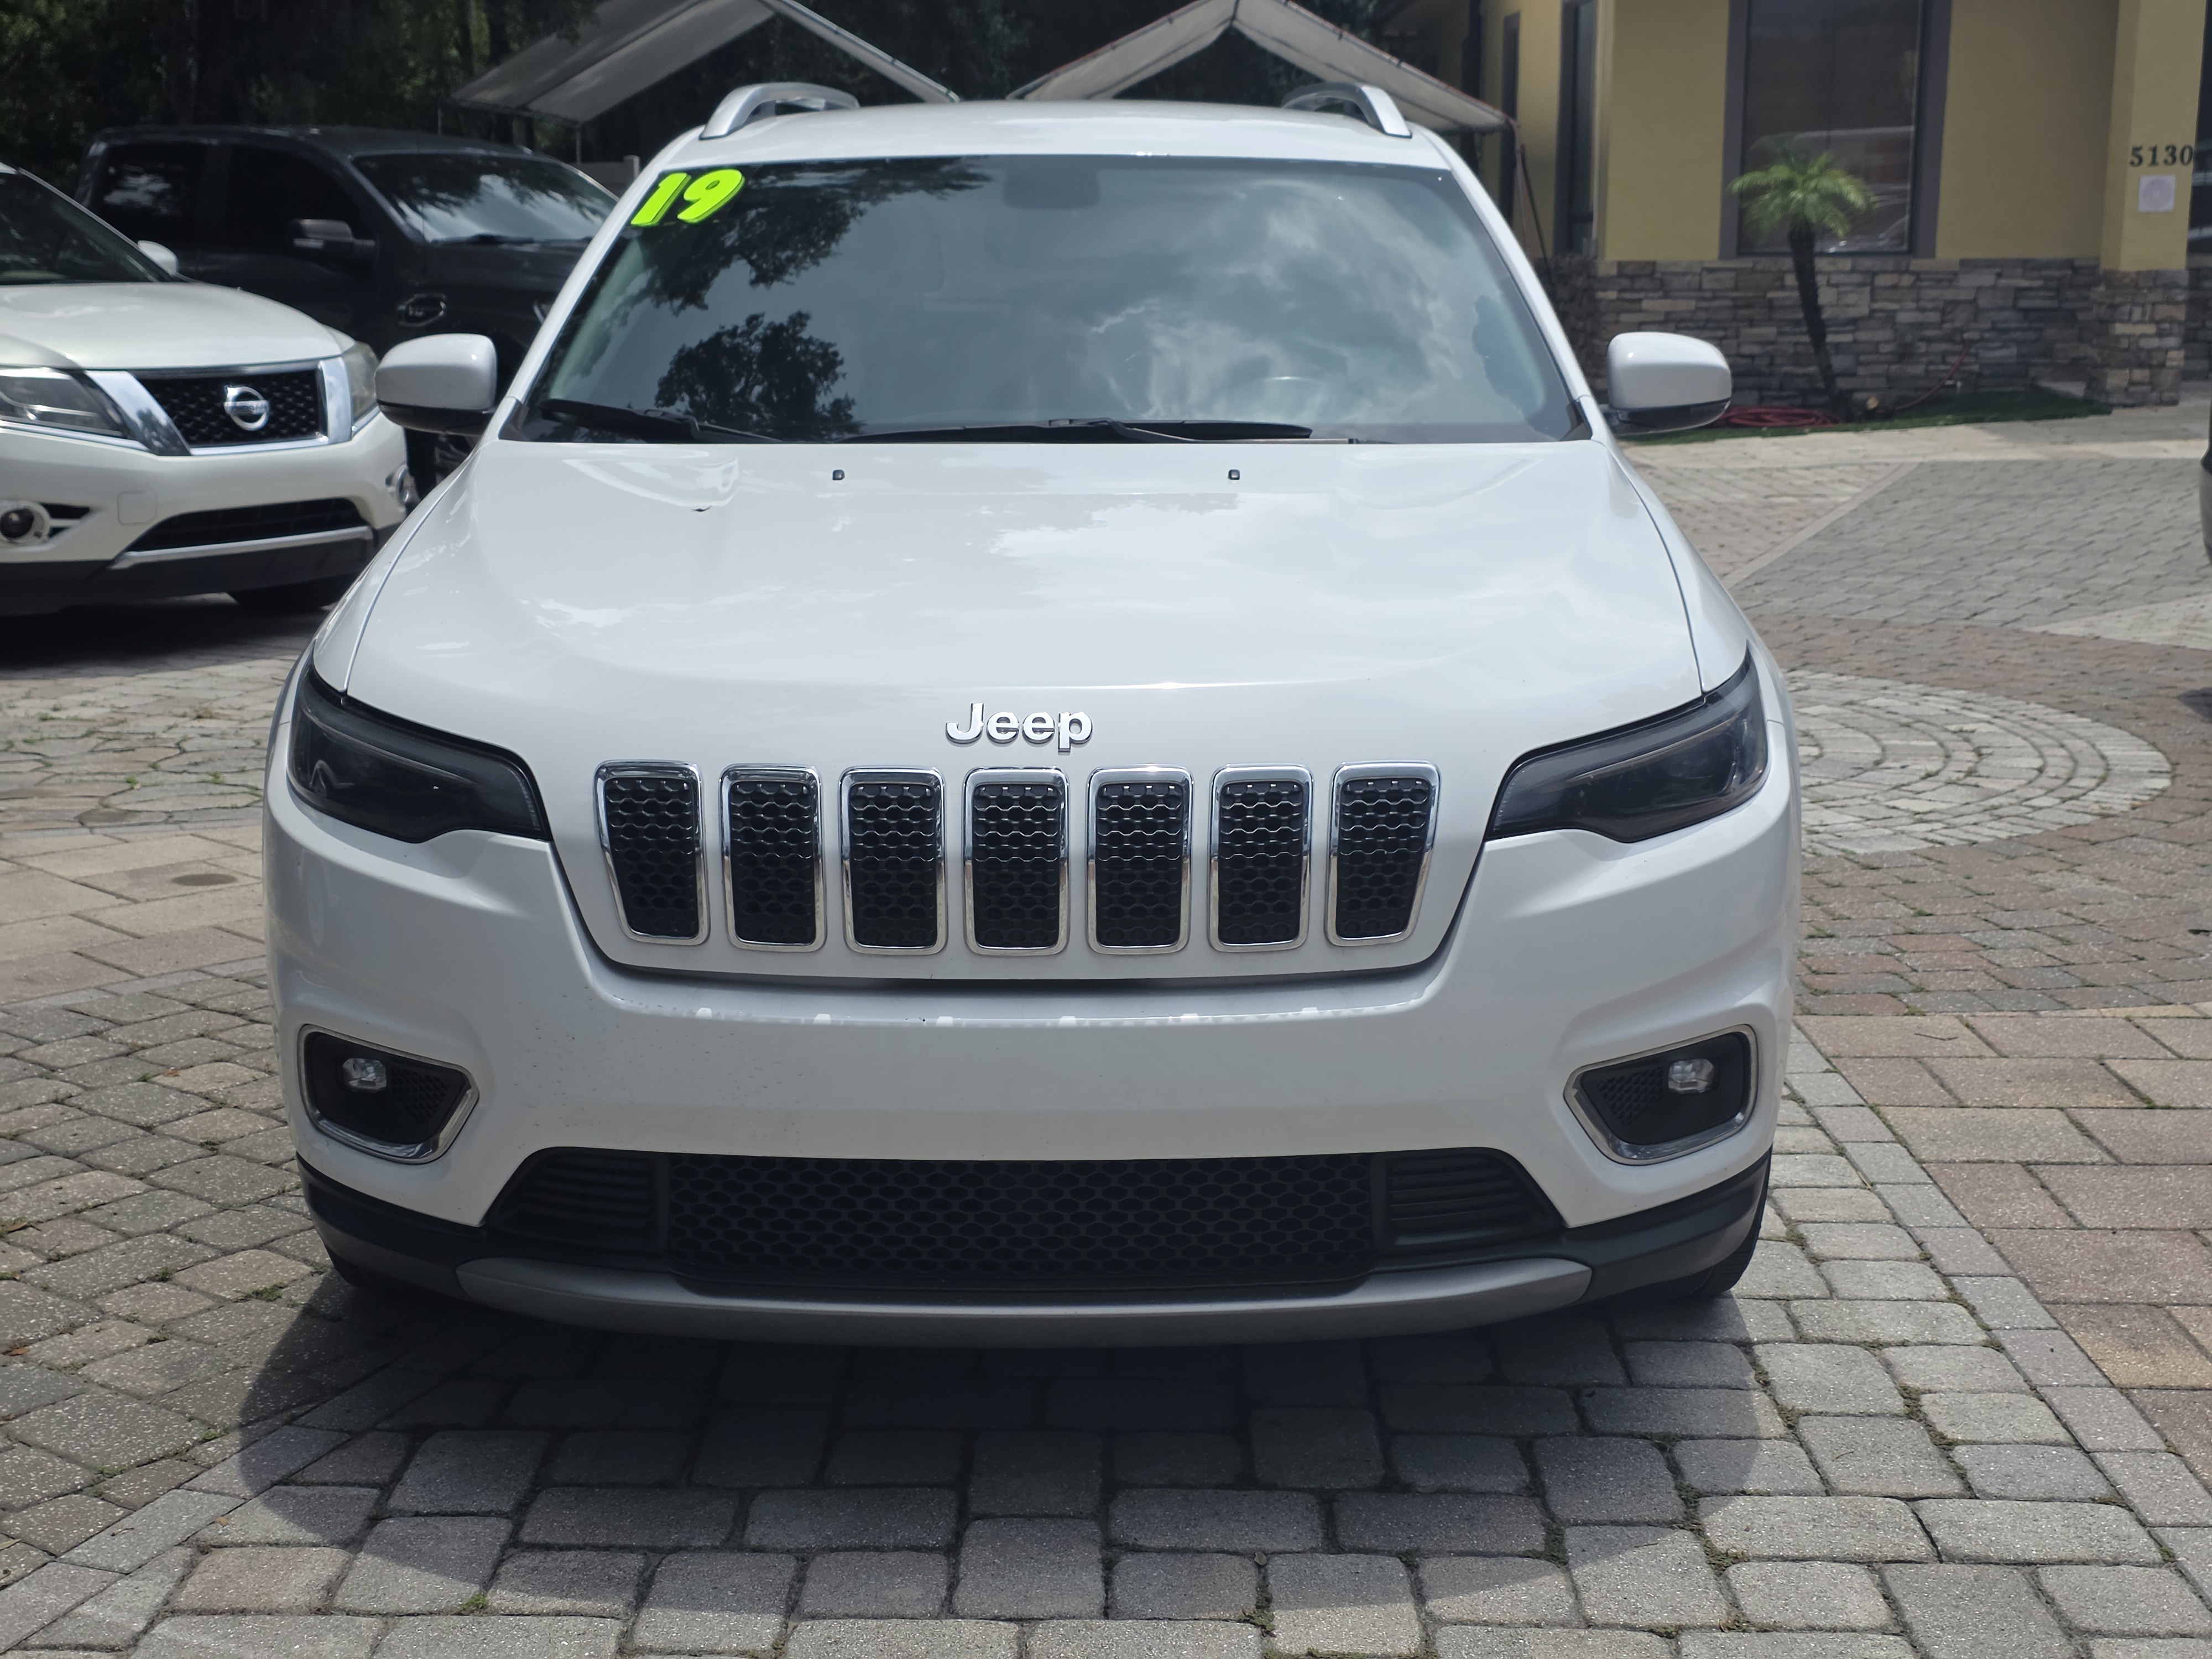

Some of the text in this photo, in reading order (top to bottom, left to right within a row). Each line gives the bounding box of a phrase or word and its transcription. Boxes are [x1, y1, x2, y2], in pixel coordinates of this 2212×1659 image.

[2130, 144, 2193, 167] 5130
[630, 169, 745, 227] 19
[945, 702, 1093, 754] Jeep
